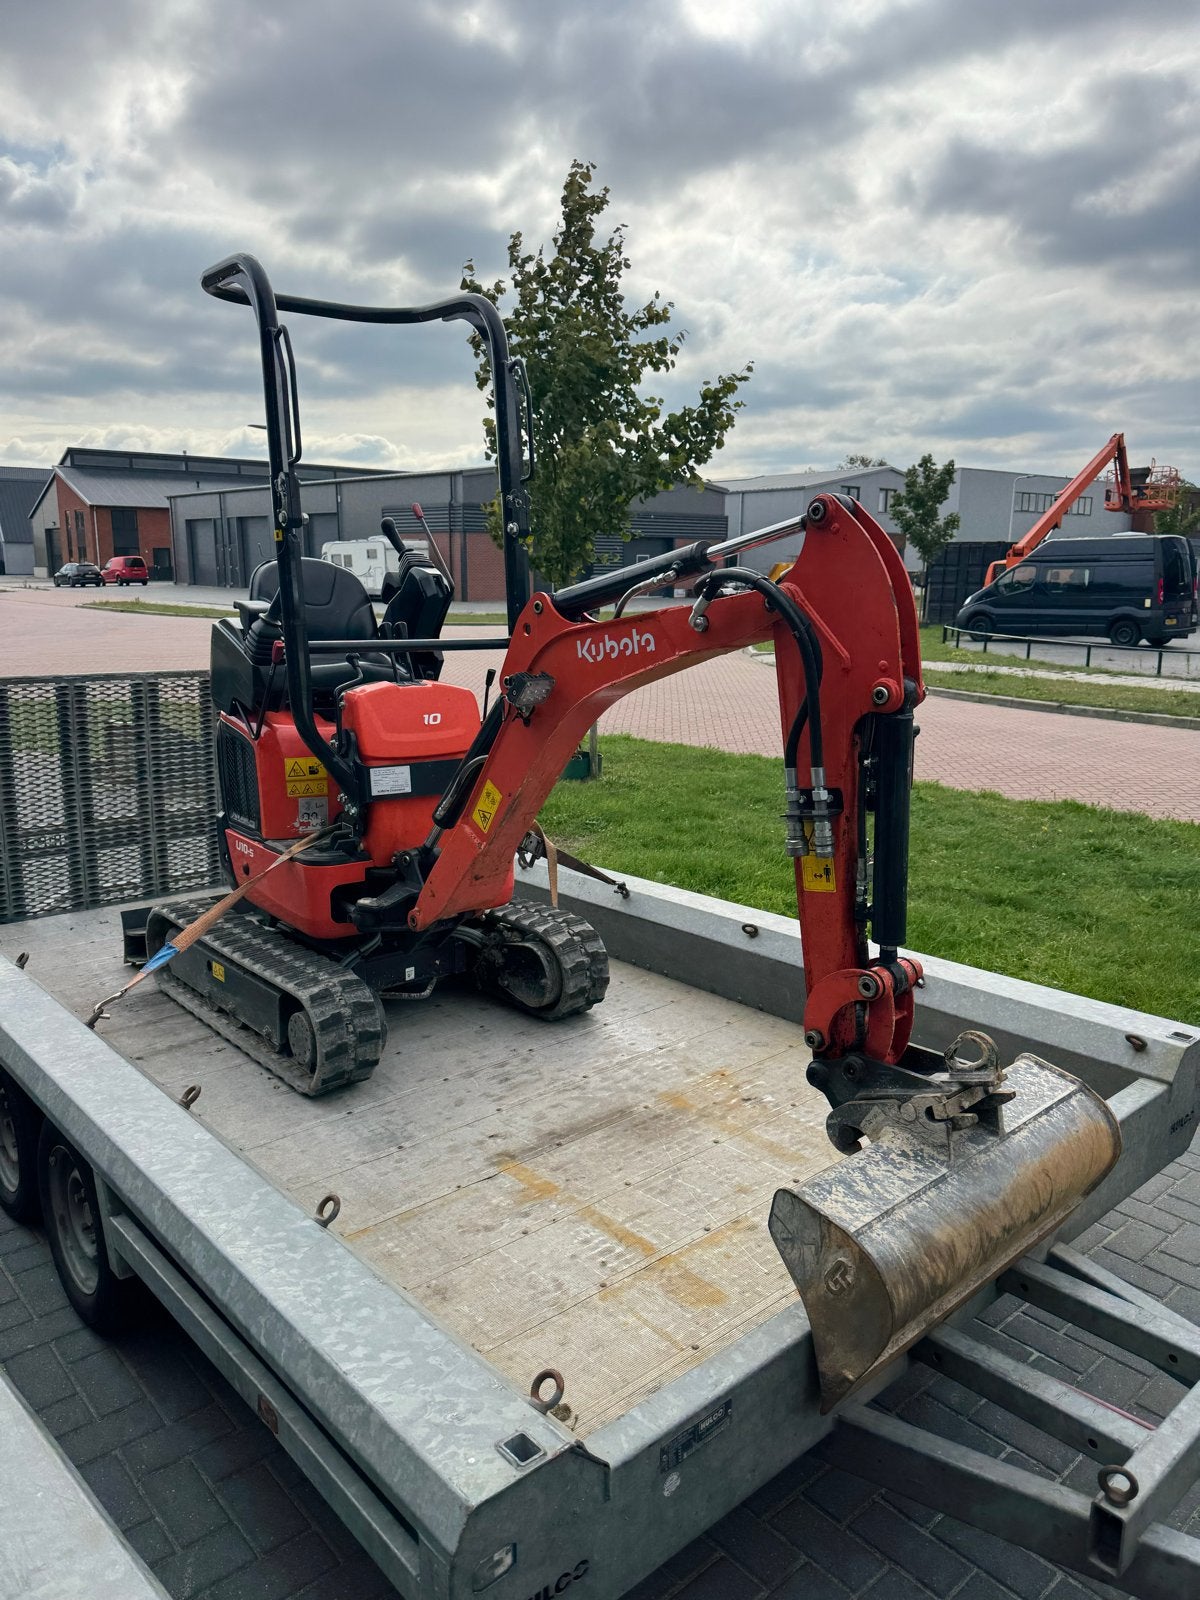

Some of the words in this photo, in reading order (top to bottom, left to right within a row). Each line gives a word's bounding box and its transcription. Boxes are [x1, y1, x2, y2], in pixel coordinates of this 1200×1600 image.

[577, 628, 656, 663] Kubota
[423, 713, 441, 725] 10
[235, 840, 255, 858] U10-5
